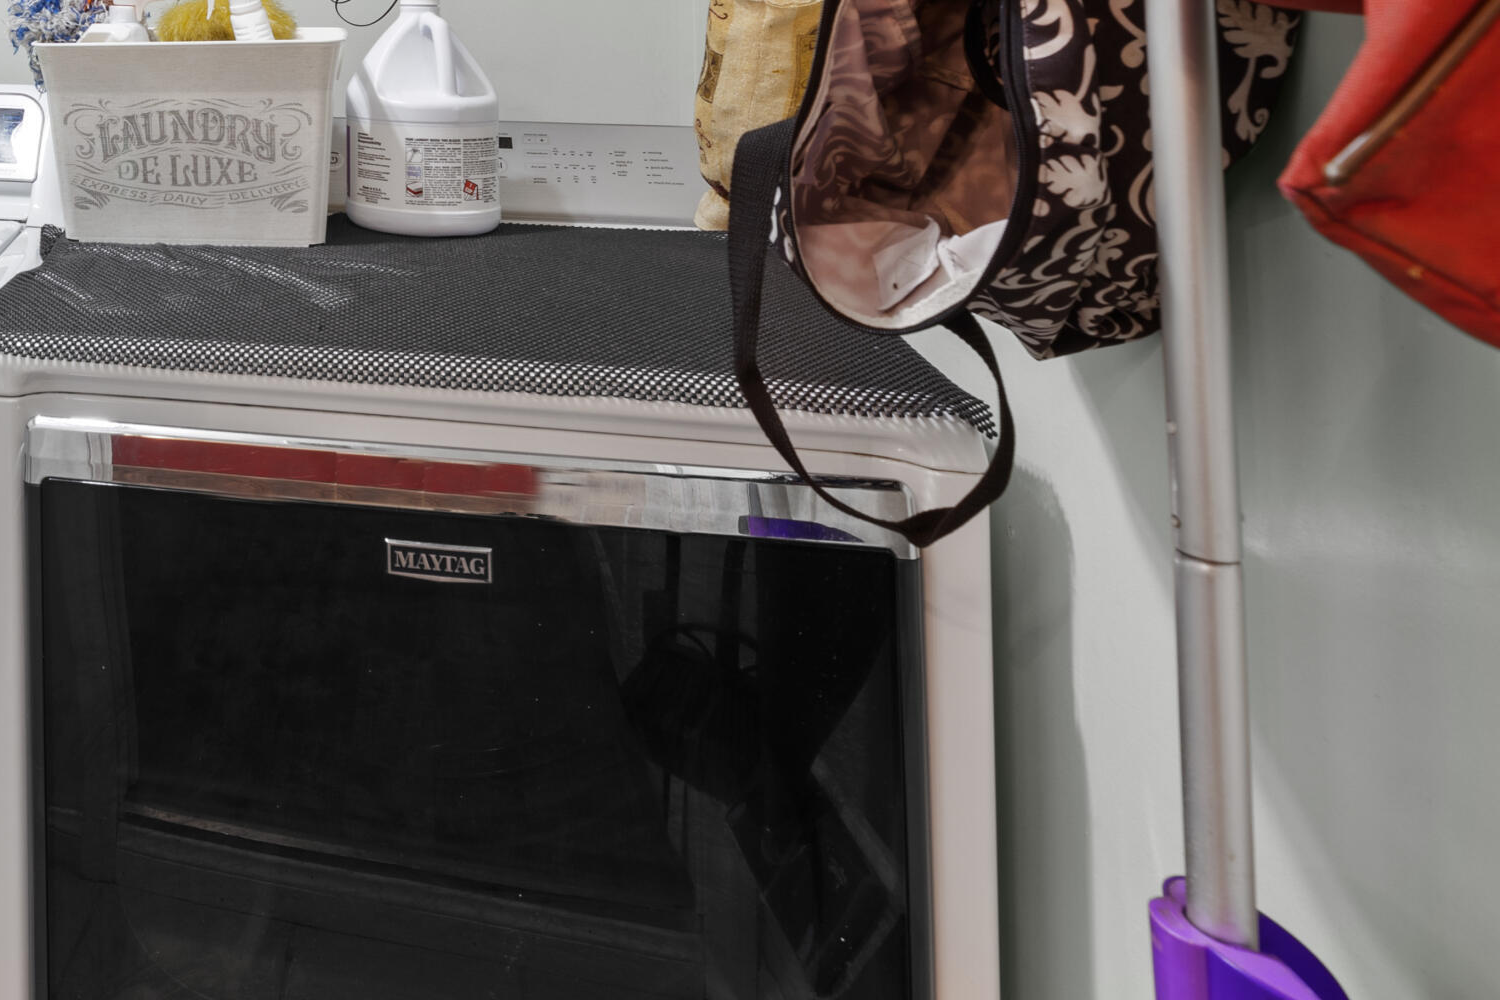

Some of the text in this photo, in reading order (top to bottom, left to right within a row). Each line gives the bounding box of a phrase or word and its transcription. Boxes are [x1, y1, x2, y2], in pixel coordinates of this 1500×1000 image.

[97, 107, 277, 164] LAUNDRY
[117, 153, 258, 187] DE LUXE
[80, 178, 303, 206] EXPRESS DAILY DELIVERY
[393, 550, 486, 575] MAYTAG
